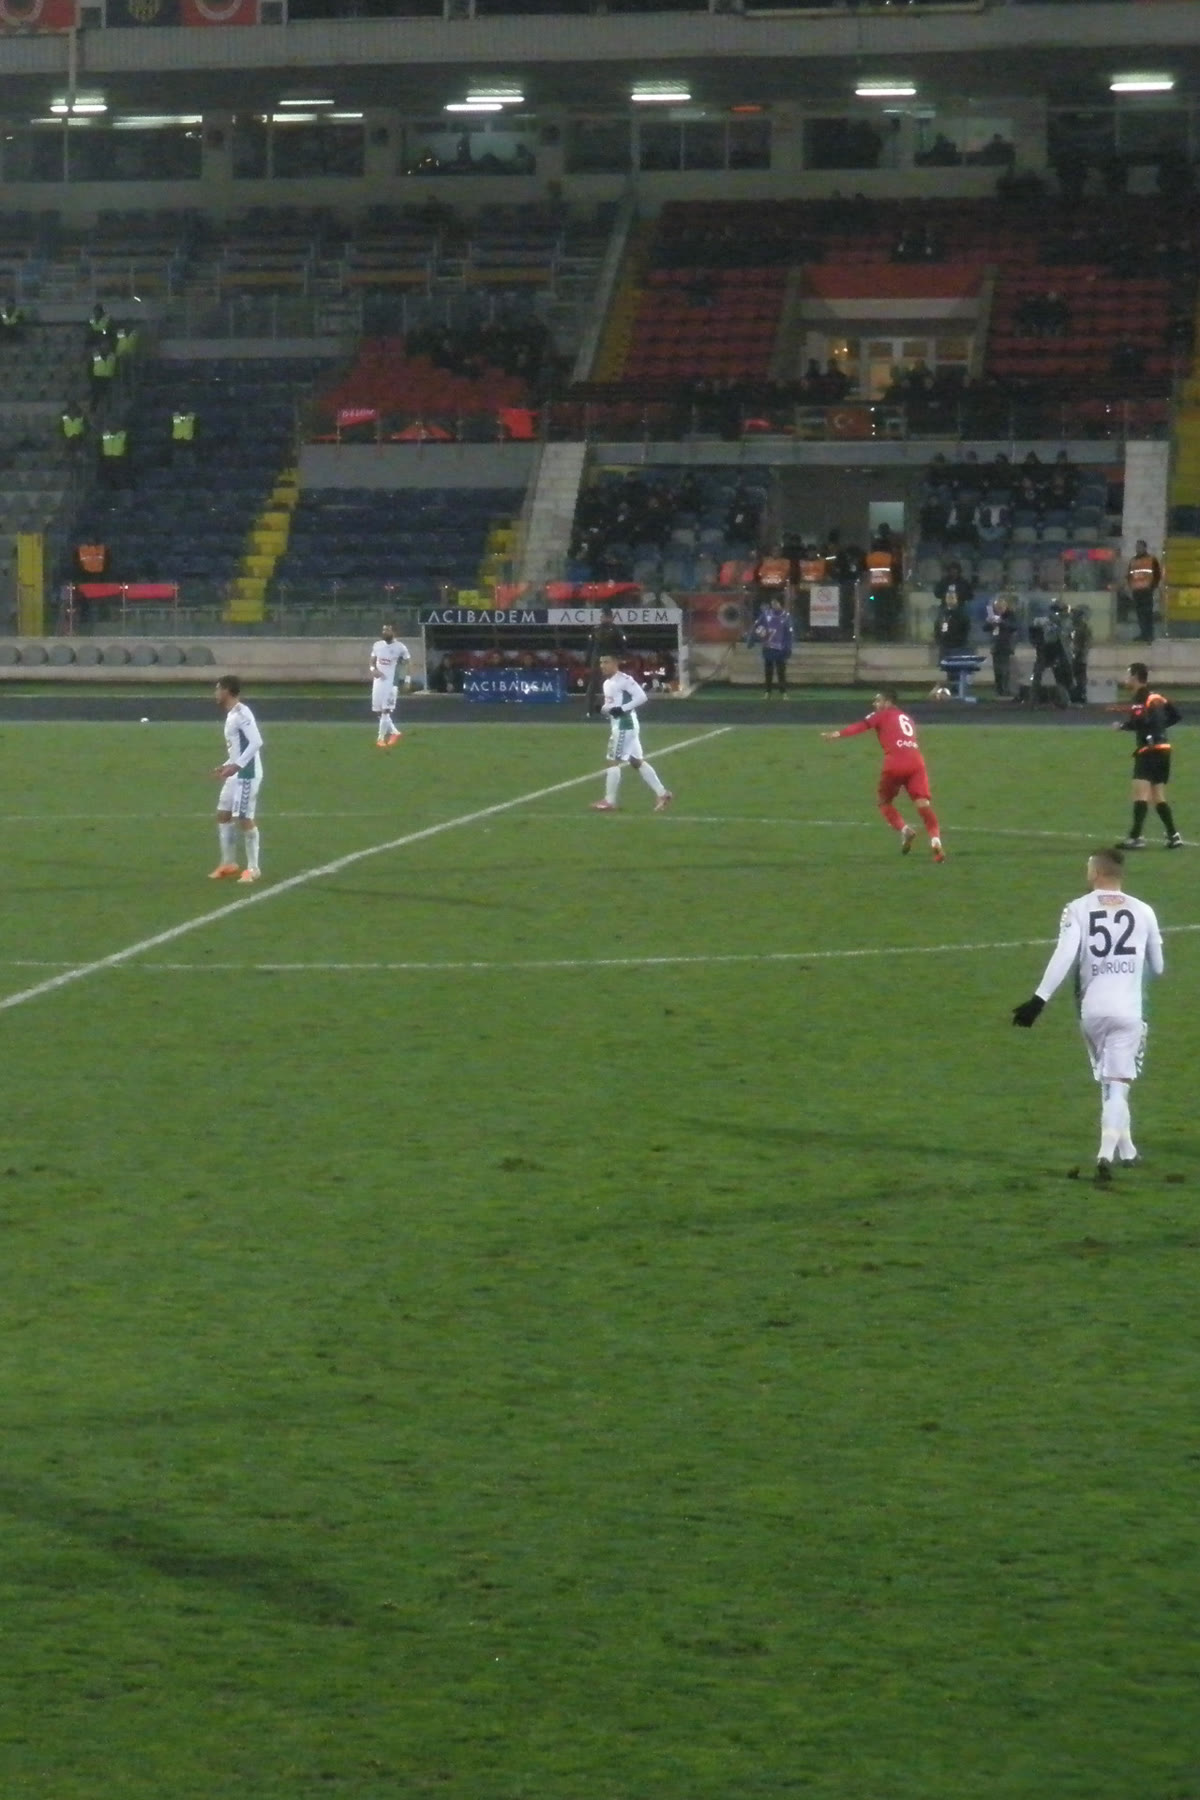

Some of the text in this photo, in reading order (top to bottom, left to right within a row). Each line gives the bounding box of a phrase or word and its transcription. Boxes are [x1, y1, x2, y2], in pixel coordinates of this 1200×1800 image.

[427, 609, 537, 623] ACIBADEM
[560, 609, 669, 622] ACIADEM
[469, 680, 554, 692] ACIBADEM
[898, 713, 914, 737] 6
[1088, 909, 1138, 958] 52
